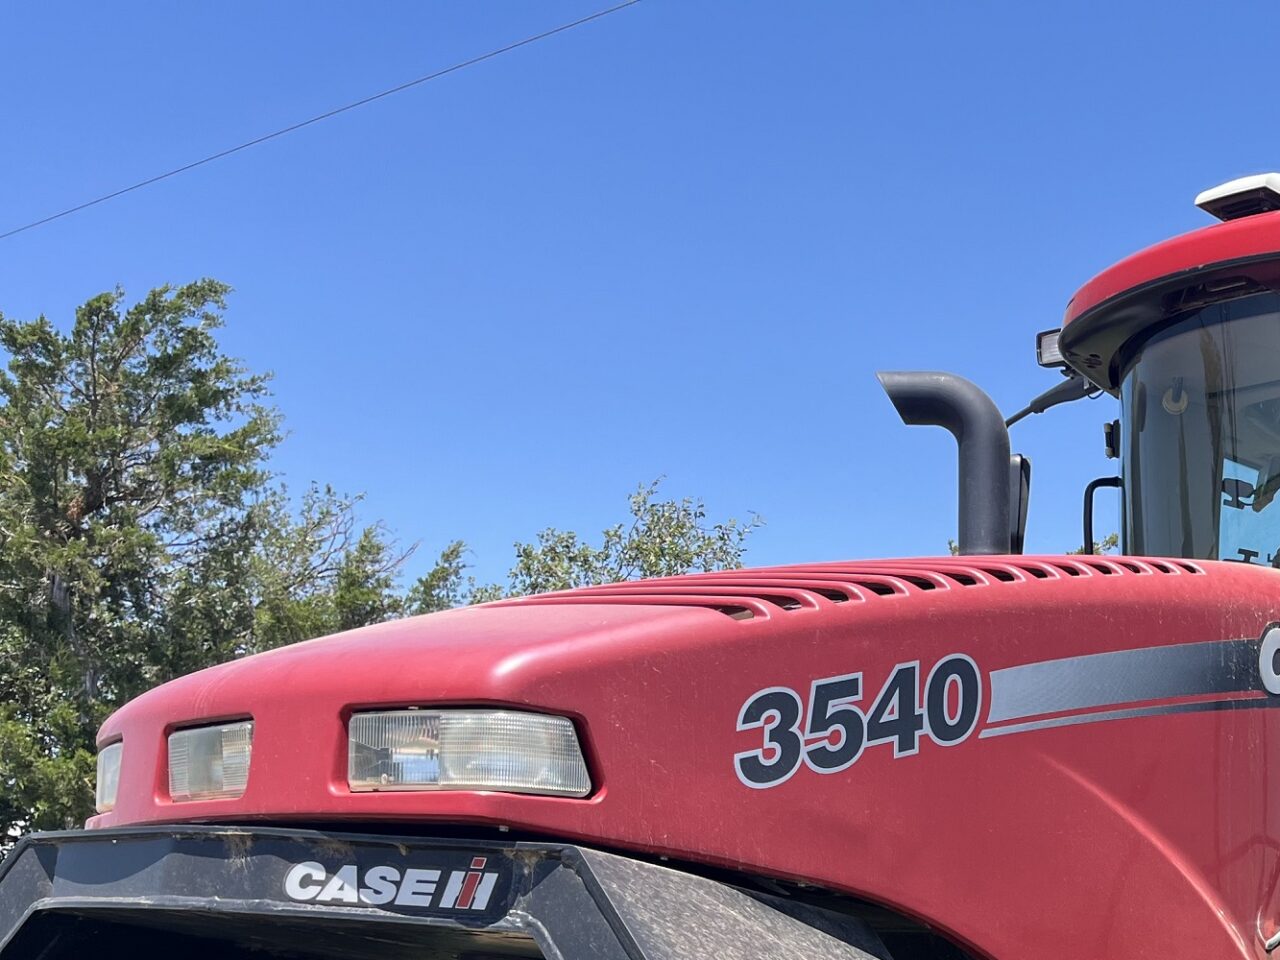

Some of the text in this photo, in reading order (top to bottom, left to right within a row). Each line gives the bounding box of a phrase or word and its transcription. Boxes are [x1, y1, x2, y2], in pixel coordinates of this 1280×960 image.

[734, 653, 982, 790] 3540
[285, 857, 499, 910] CASE IH
